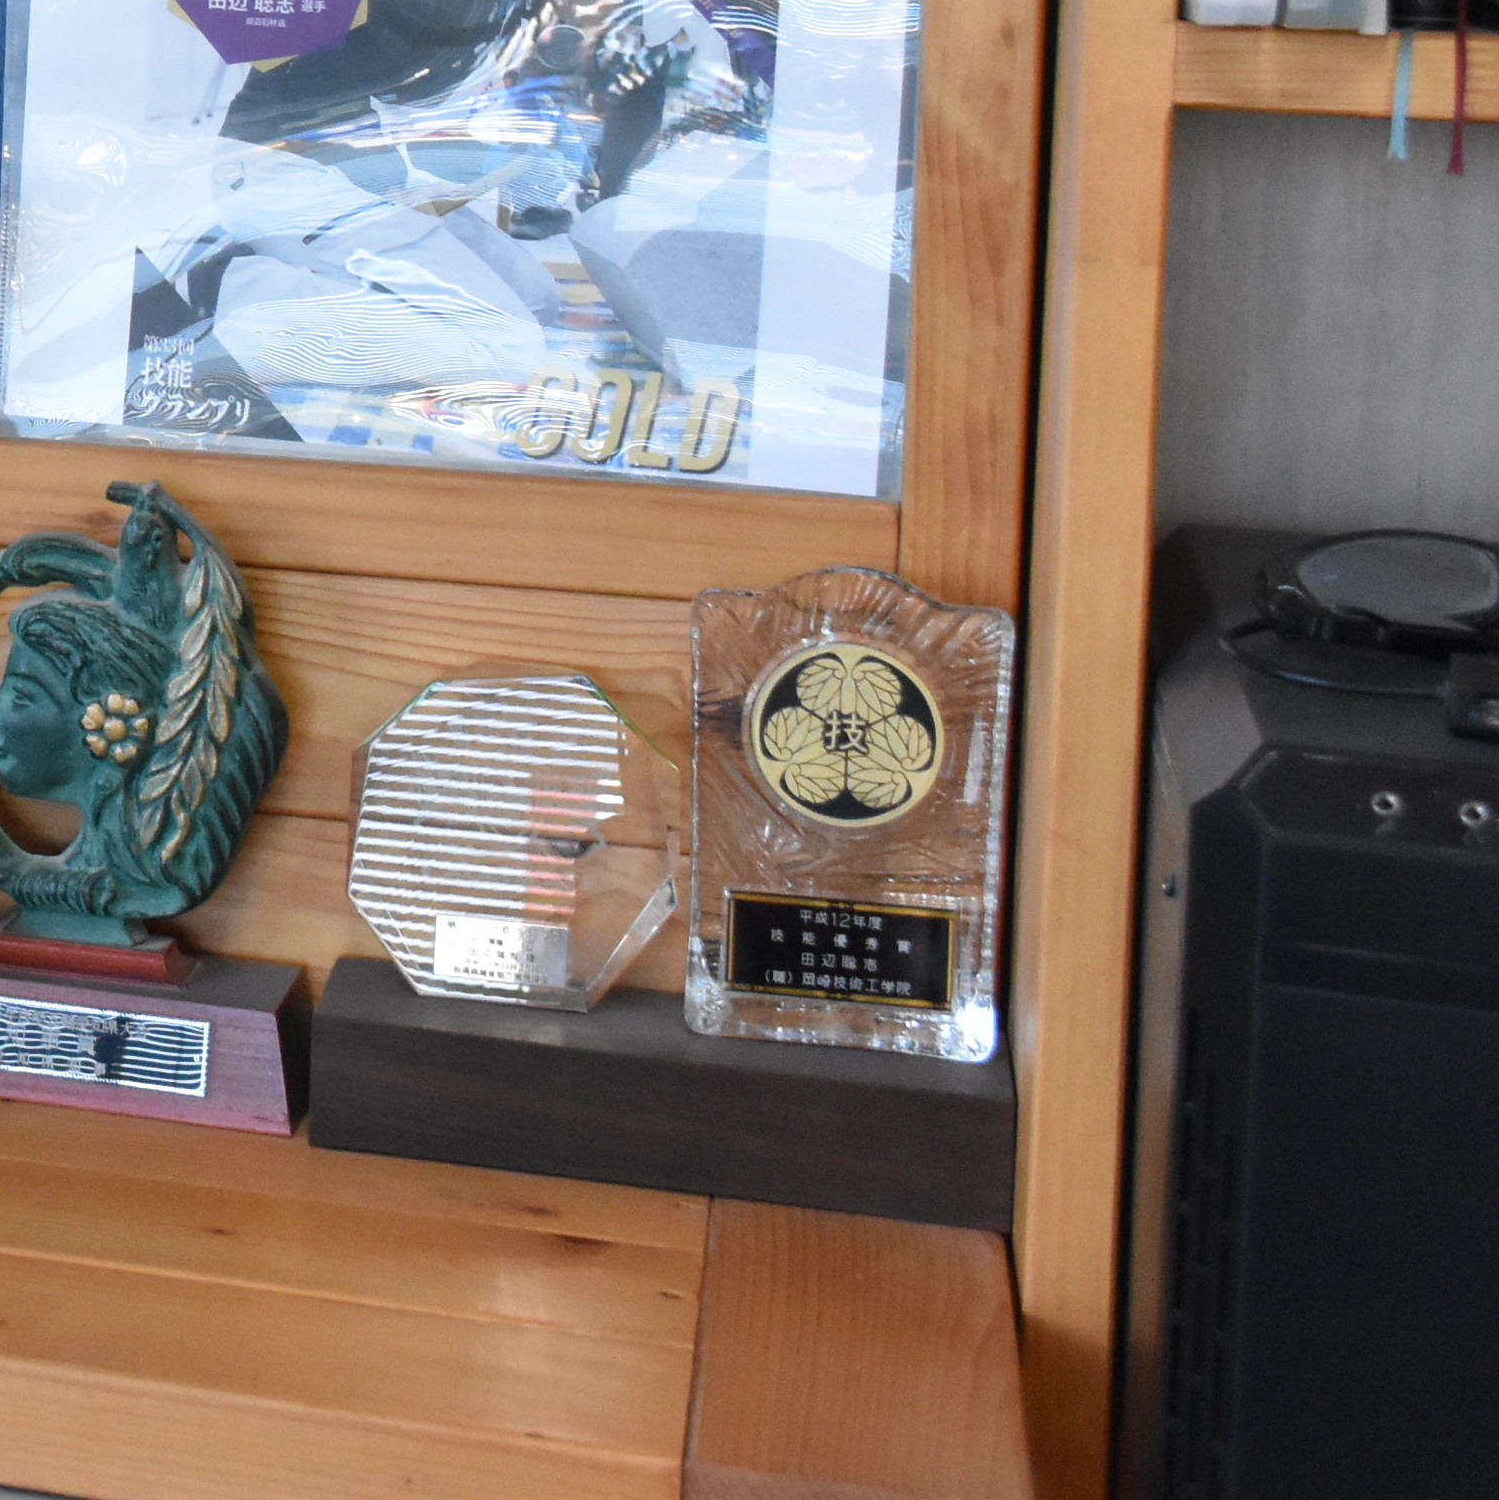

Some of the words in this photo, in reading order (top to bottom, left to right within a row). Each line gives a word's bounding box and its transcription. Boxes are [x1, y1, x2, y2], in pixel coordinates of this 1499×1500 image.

[300, 0, 327, 14] 選手
[141, 357, 193, 388] 技能
[515, 363, 741, 473] GOLD
[824, 711, 870, 755] 技
[799, 909, 883, 931] 平成12年度
[770, 928, 912, 954] 技能優秀賞
[800, 953, 878, 972] 田辺聡志
